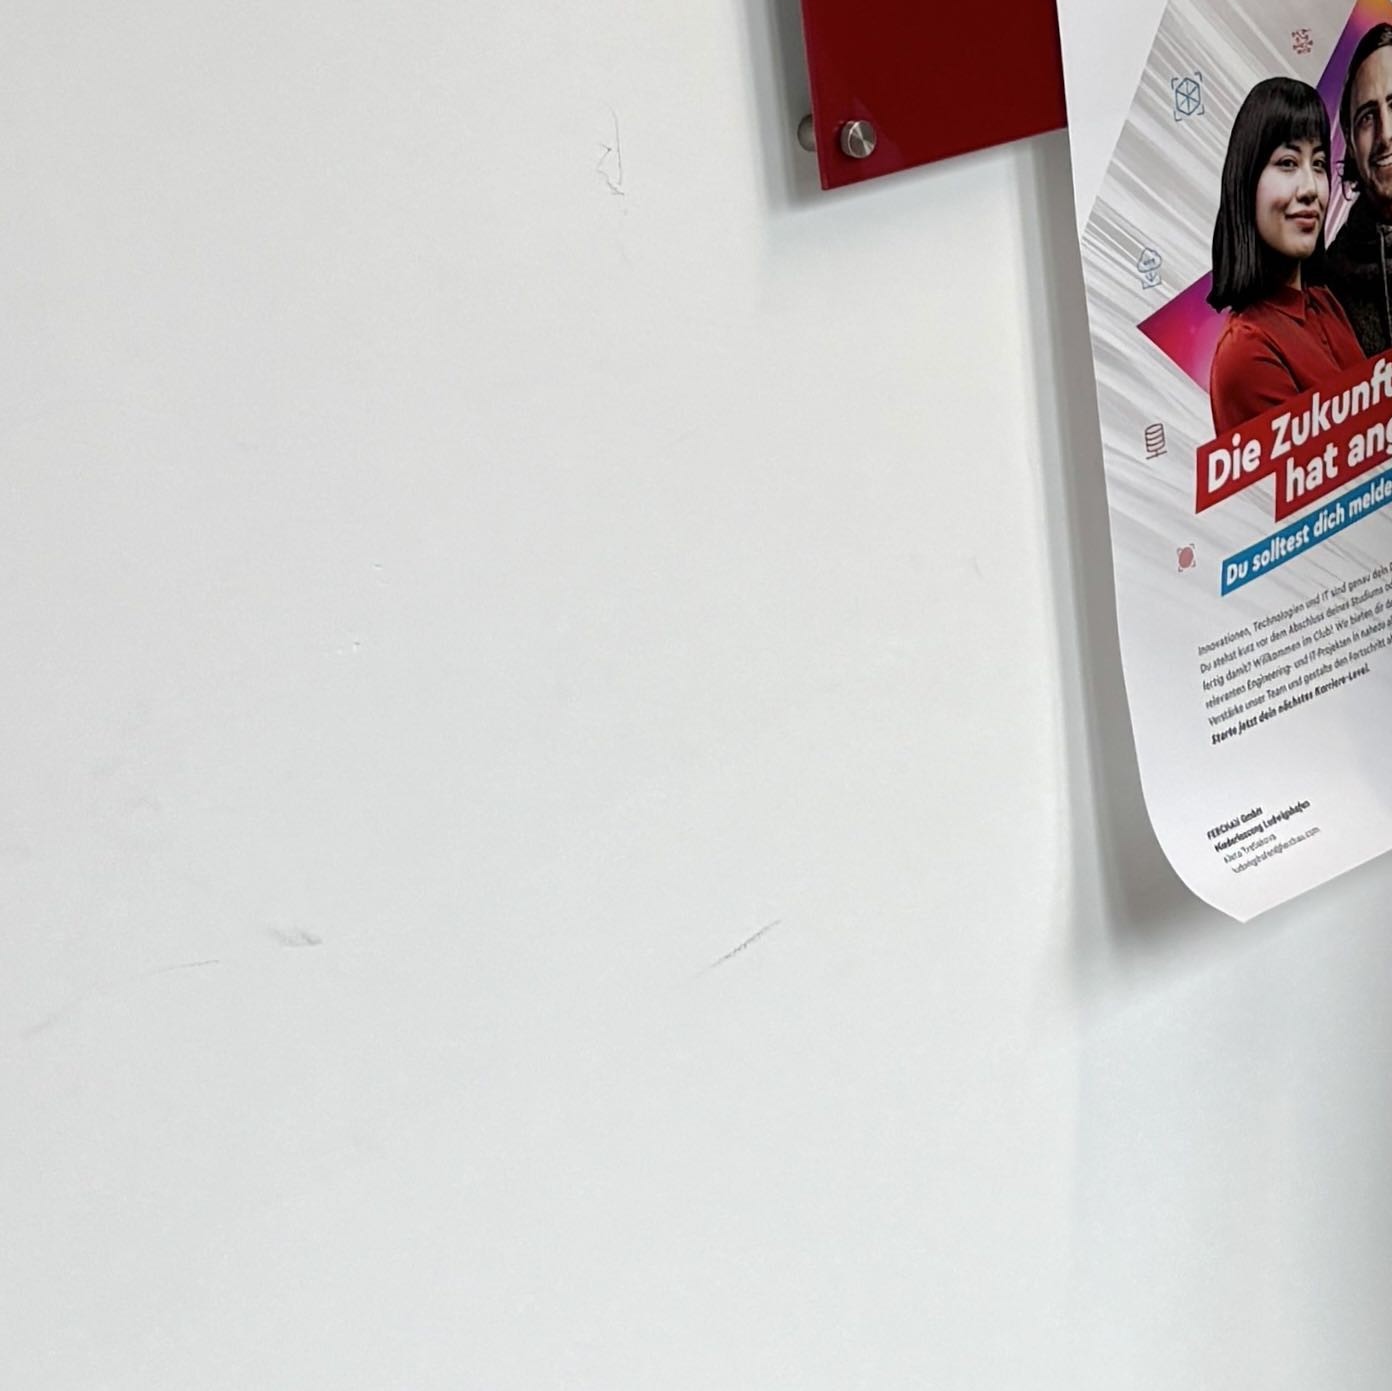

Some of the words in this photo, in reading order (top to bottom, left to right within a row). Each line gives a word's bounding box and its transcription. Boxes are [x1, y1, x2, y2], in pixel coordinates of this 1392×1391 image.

[1207, 433, 1261, 494] Die
[1286, 443, 1338, 503] hat
[1226, 560, 1248, 586] Du
[1252, 527, 1310, 573] solltest
[1313, 502, 1345, 538] dich
[1253, 603, 1305, 632] Technologien
